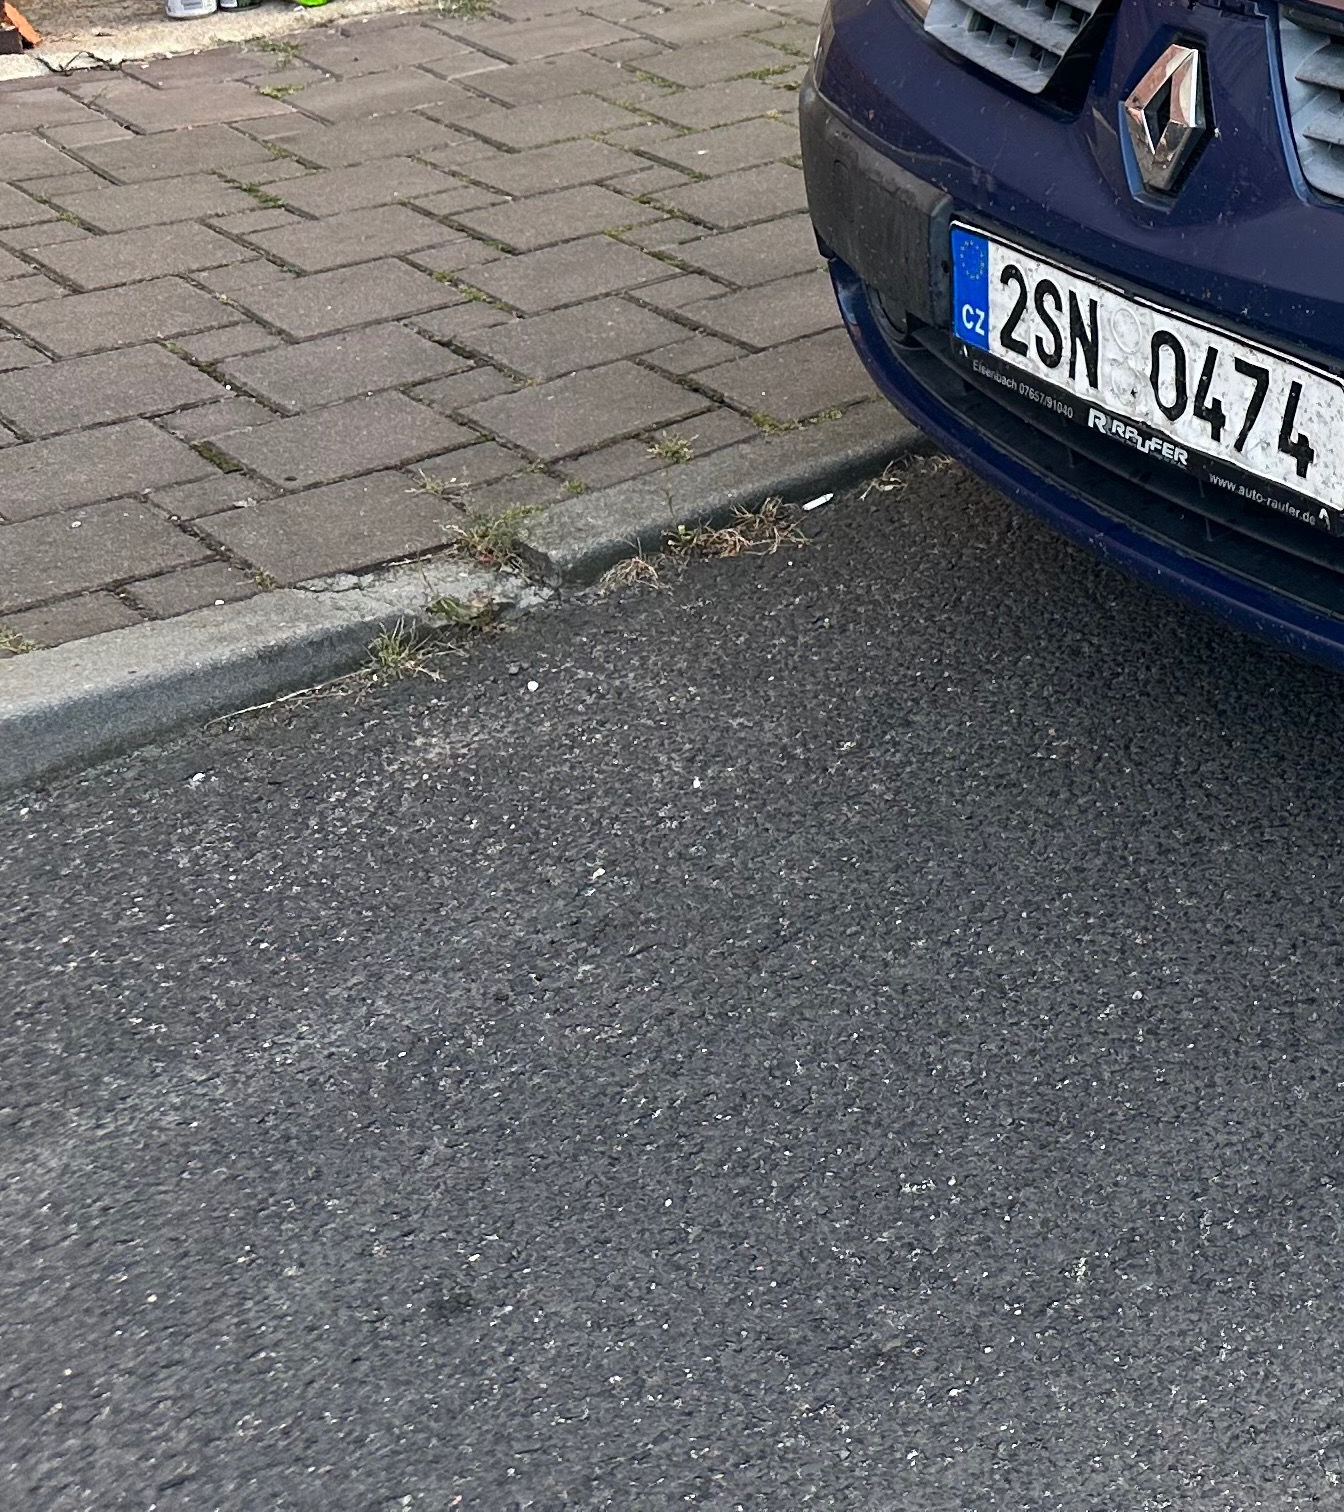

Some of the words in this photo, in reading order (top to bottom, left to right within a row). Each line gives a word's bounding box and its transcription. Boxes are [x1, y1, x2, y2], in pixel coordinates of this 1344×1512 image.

[961, 303, 985, 337] CZ
[972, 359, 1018, 391] Eisenbach
[999, 263, 1100, 390] 2SN
[1149, 329, 1315, 479] 0474
[1208, 473, 1316, 527] www.auto-raufer.de
